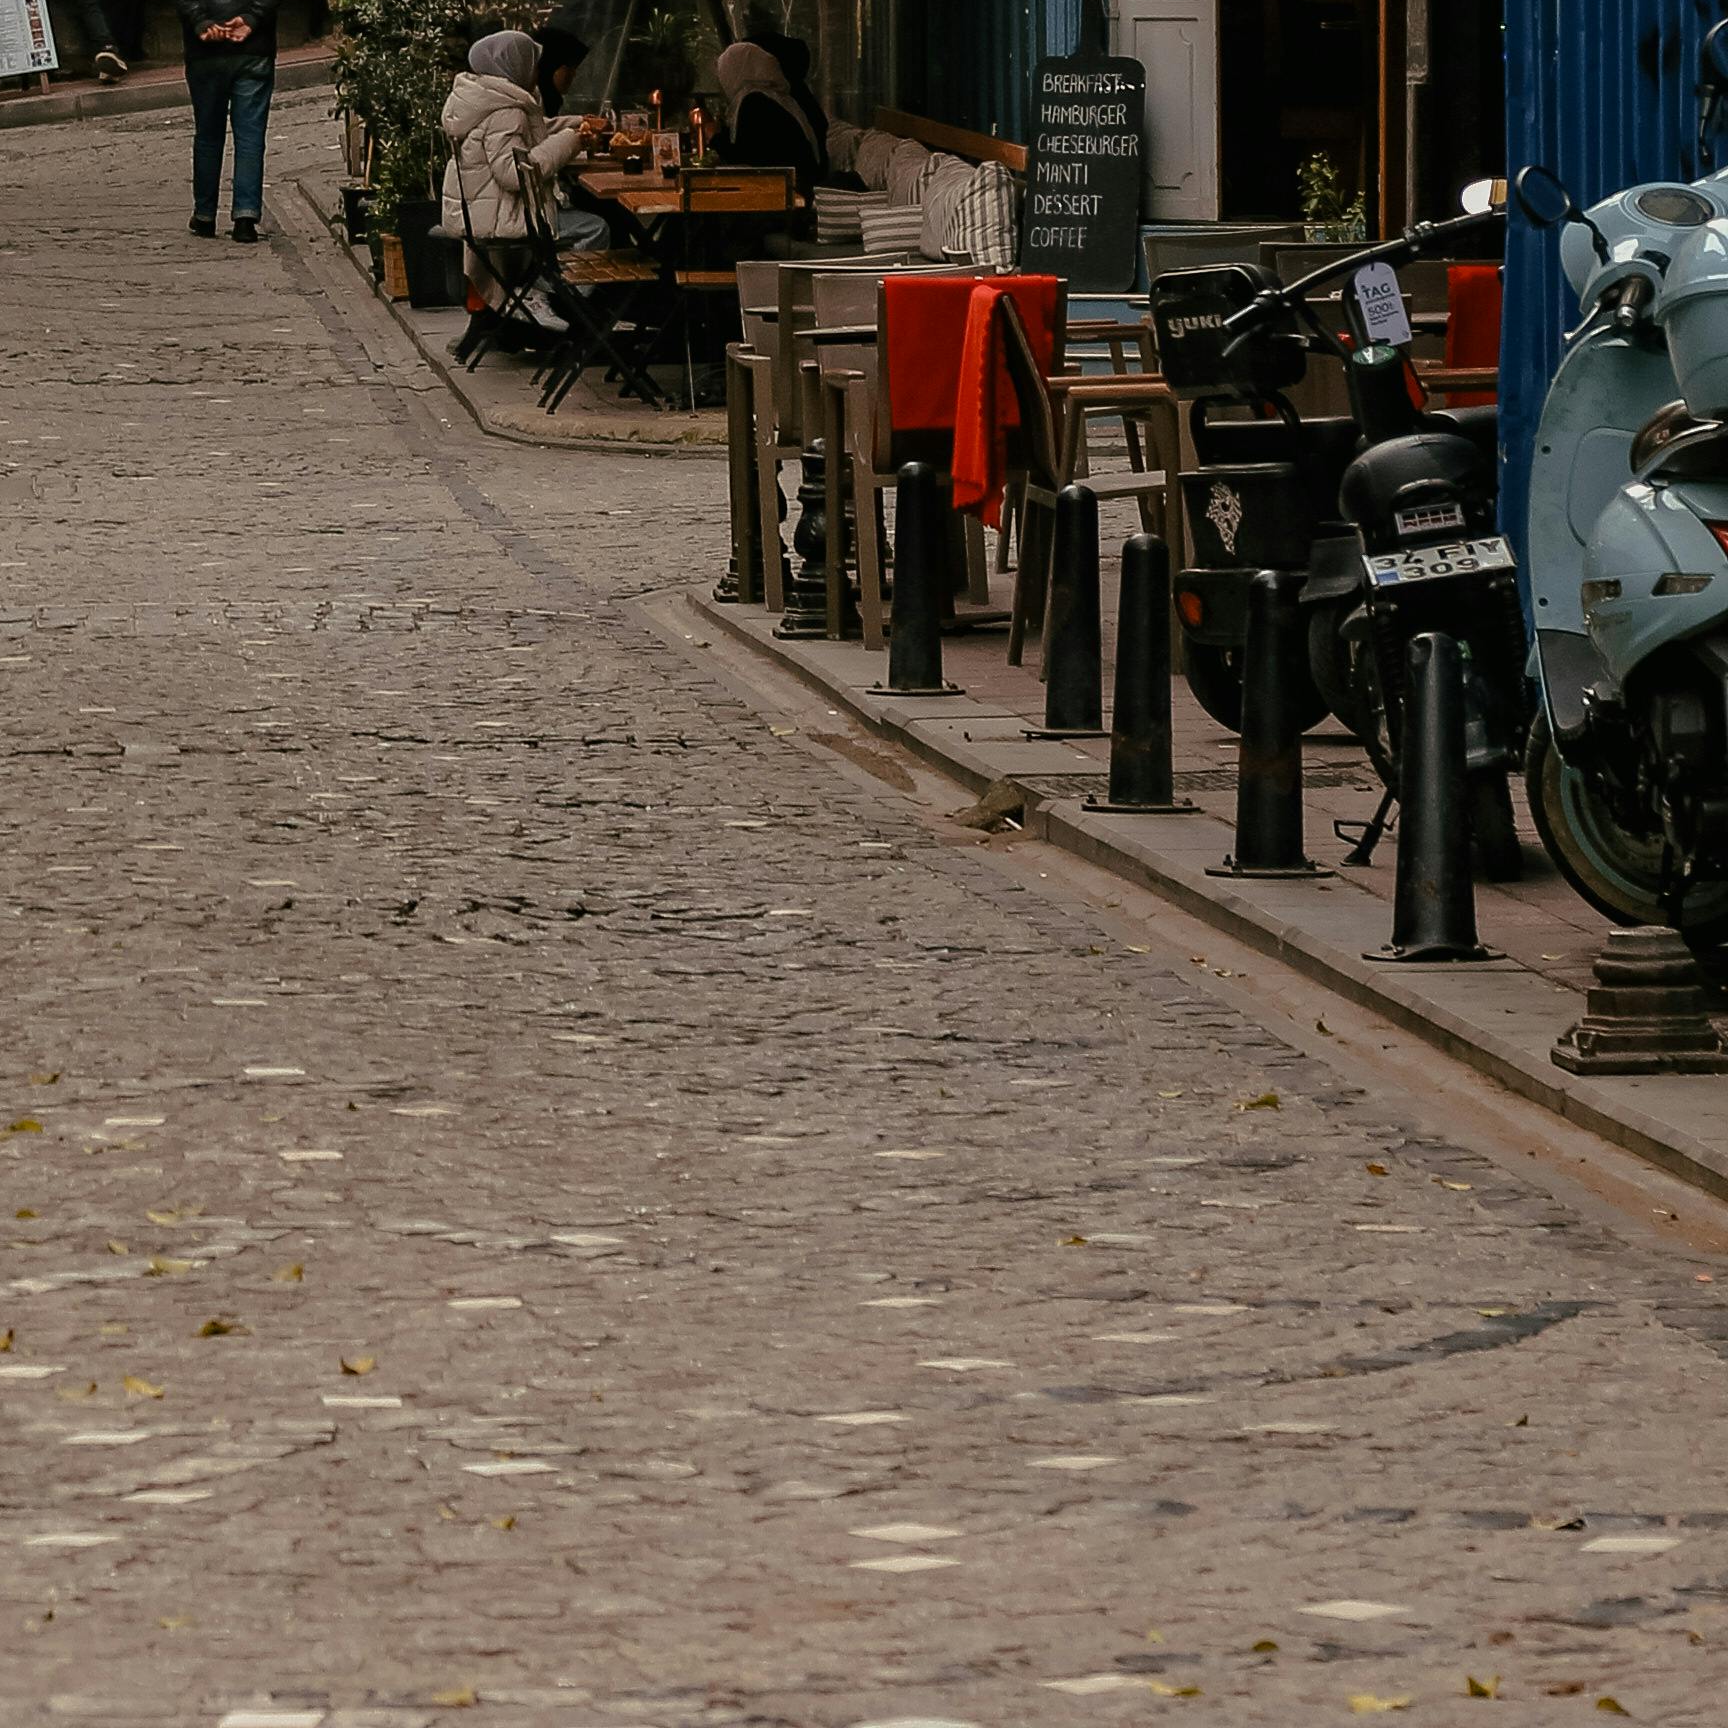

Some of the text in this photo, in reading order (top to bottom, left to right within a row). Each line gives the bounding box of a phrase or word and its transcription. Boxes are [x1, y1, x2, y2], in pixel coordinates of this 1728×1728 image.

[1042, 73, 1123, 94] BREAKFAST
[1041, 103, 1127, 128] HAMBURGER
[1037, 133, 1139, 156] CHEESEBURGER
[1036, 162, 1088, 185] MANTI
[1034, 194, 1103, 216] DESSERT
[1030, 226, 1088, 249] COFFEE
[1362, 283, 1391, 300] TAG
[1374, 550, 1424, 570] 34
[1402, 557, 1480, 579] 309
